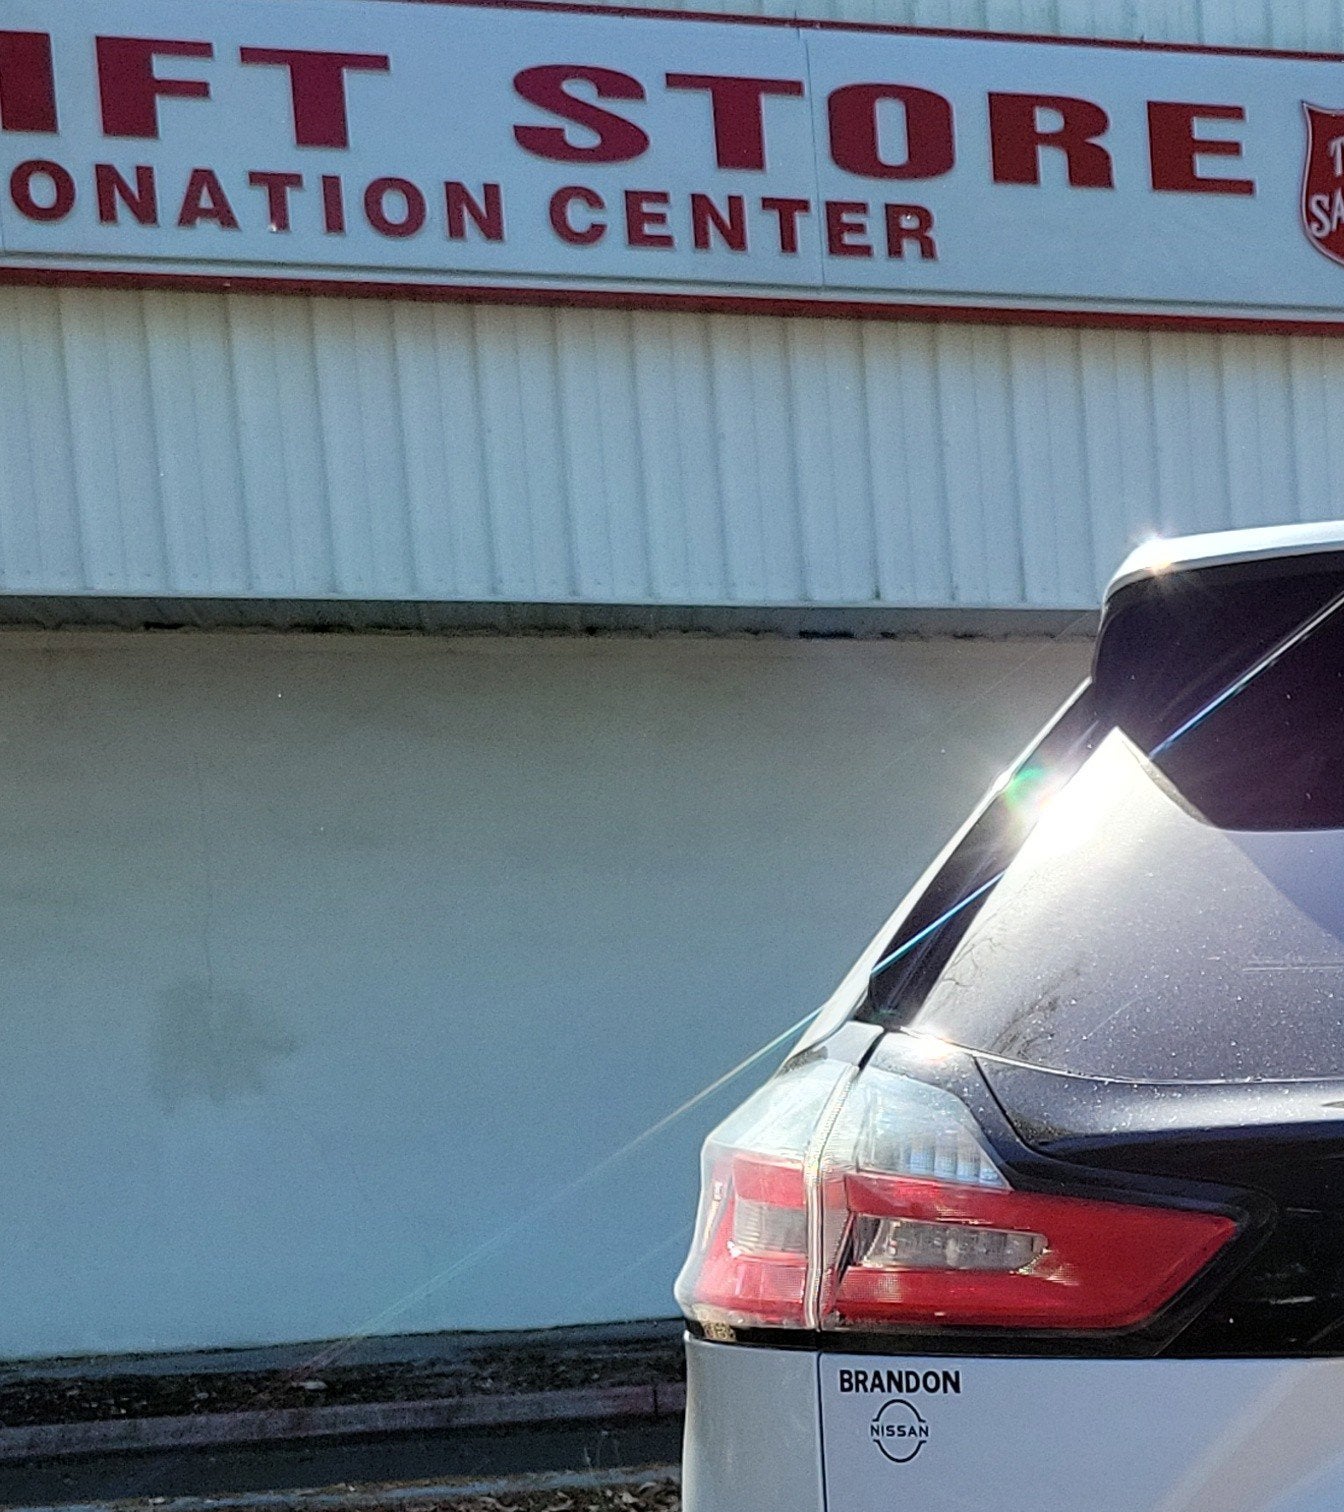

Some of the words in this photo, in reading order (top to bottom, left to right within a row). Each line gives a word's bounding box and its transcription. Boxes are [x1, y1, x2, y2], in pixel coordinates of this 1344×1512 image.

[0, 31, 389, 148] IFT
[513, 64, 1255, 195] STORE
[8, 159, 505, 243] ONATION
[549, 185, 939, 262] CENTER
[839, 1369, 961, 1394] BRANDON
[870, 1424, 929, 1438] NISSAN
